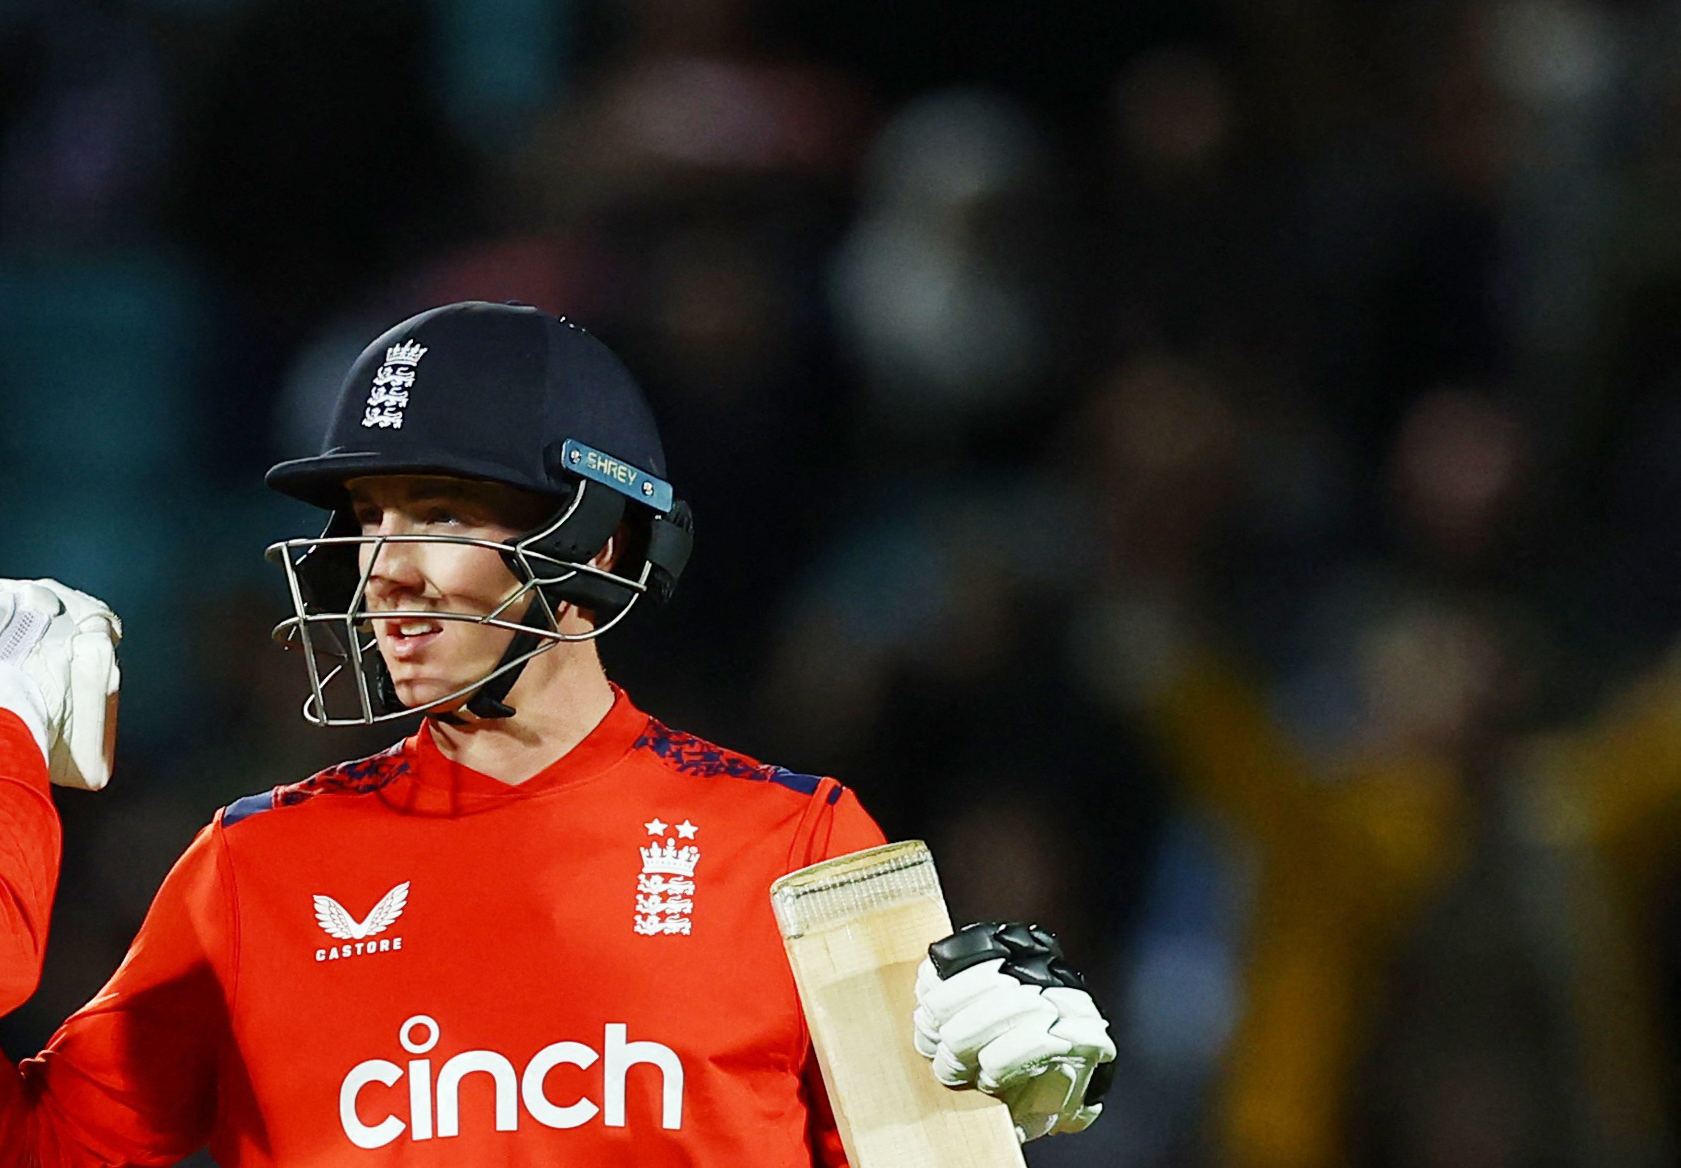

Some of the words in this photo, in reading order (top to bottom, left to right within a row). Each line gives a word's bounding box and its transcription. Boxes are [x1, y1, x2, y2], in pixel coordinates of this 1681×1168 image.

[585, 452, 637, 486] SHREY
[315, 937, 403, 962] CASTORE
[339, 1014, 685, 1150] cinch
